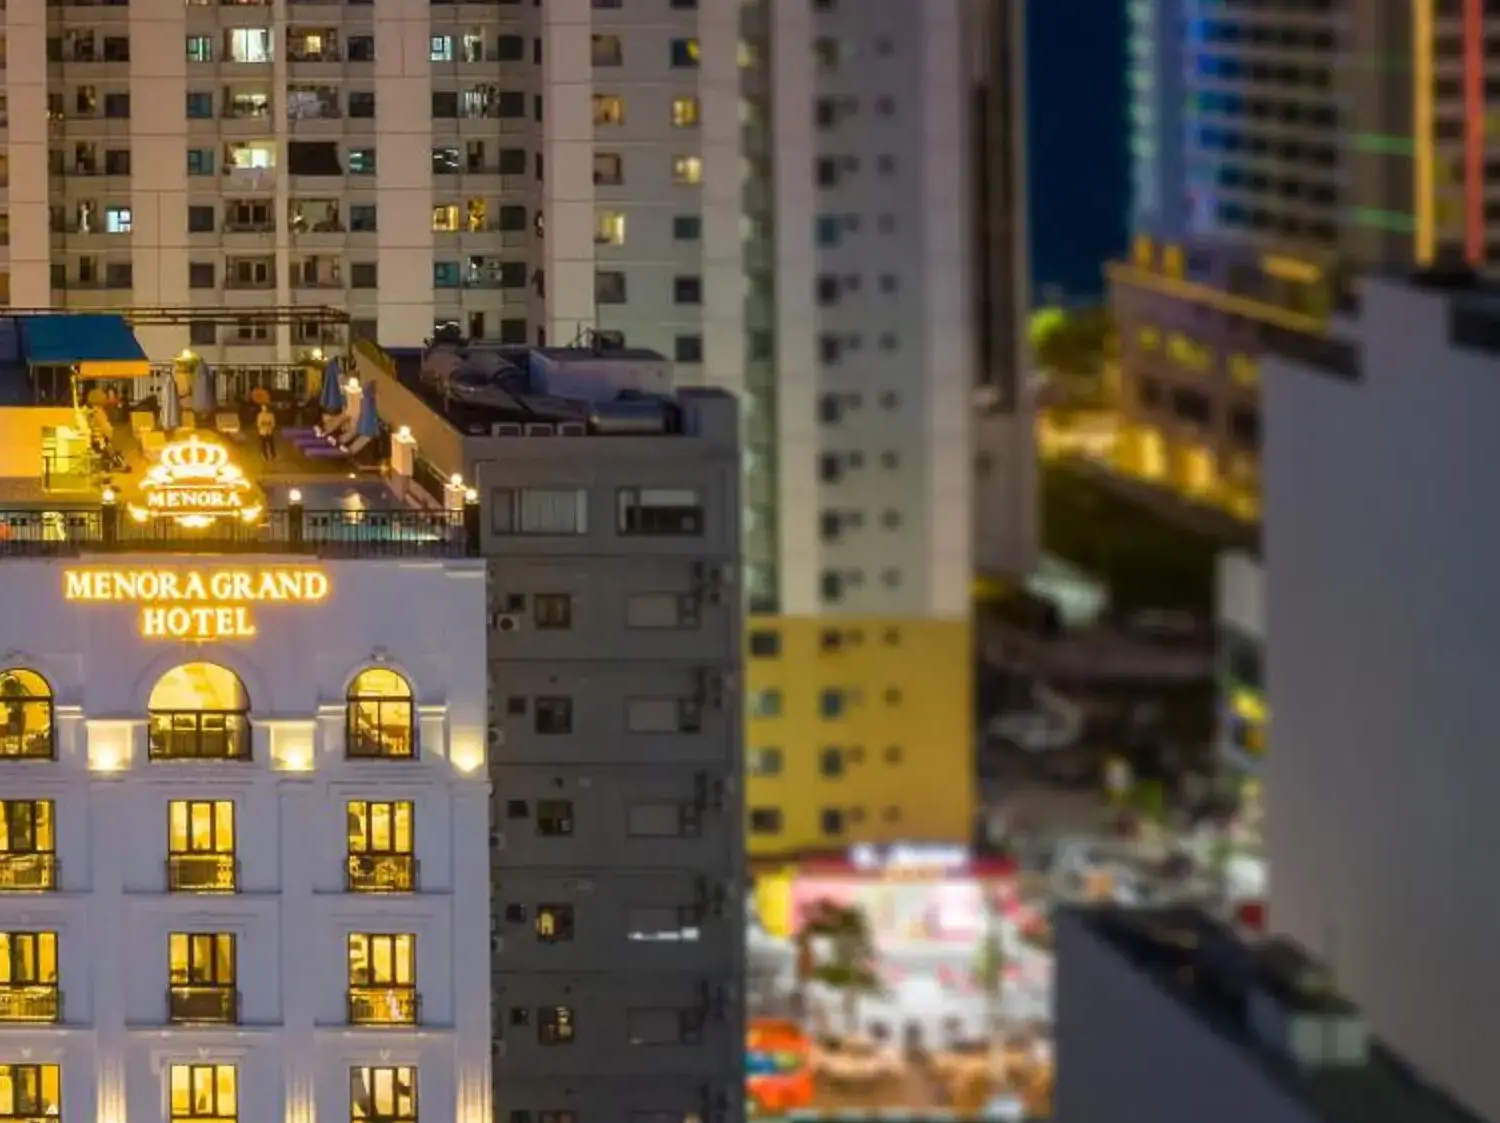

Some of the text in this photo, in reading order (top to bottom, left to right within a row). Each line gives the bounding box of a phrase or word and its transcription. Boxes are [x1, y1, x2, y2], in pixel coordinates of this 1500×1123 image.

[147, 490, 243, 507] MENORA
[64, 570, 329, 600] MENORA GRAND
[142, 606, 257, 636] HOTEL
